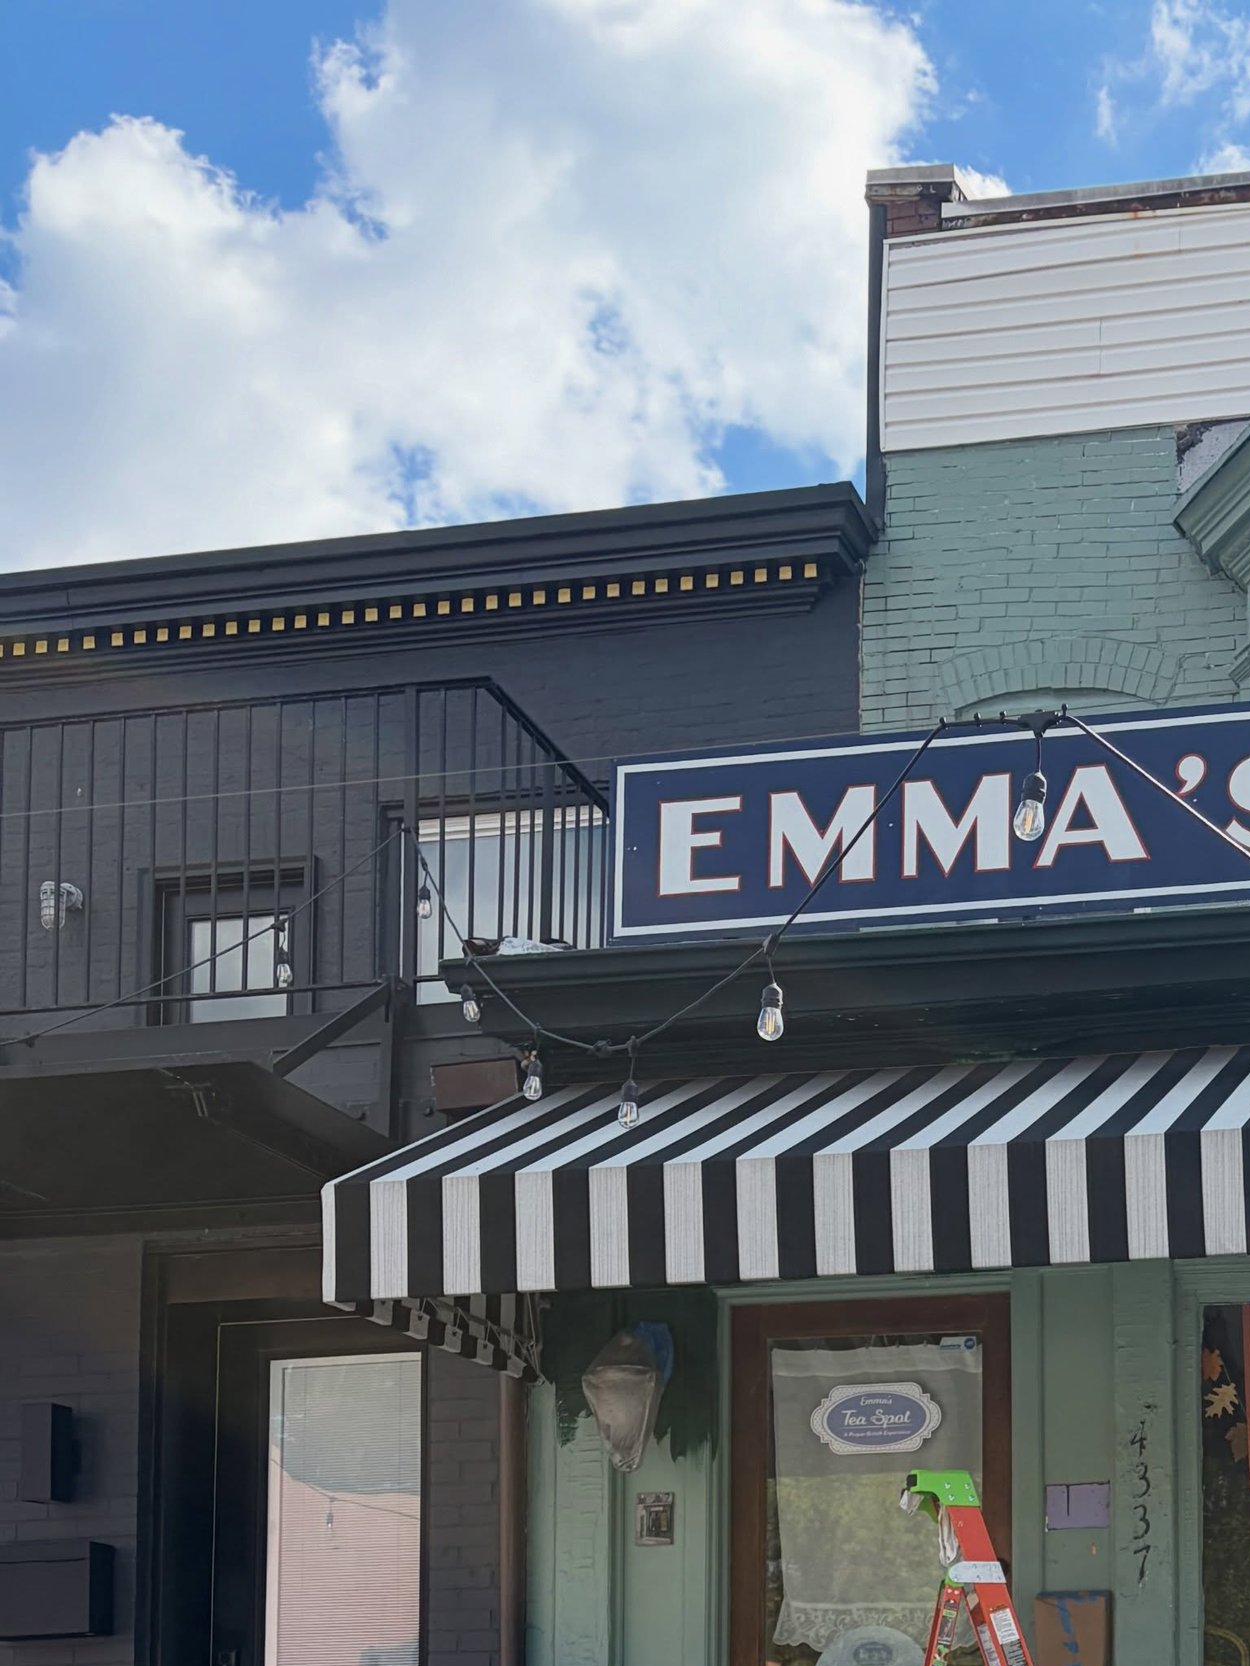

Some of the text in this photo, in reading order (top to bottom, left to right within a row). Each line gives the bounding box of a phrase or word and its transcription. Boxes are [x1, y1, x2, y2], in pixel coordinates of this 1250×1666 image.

[860, 1395, 893, 1406] Emma's
[841, 1408, 912, 1429] Tea Spot
[1130, 1420, 1151, 1586] 4337
